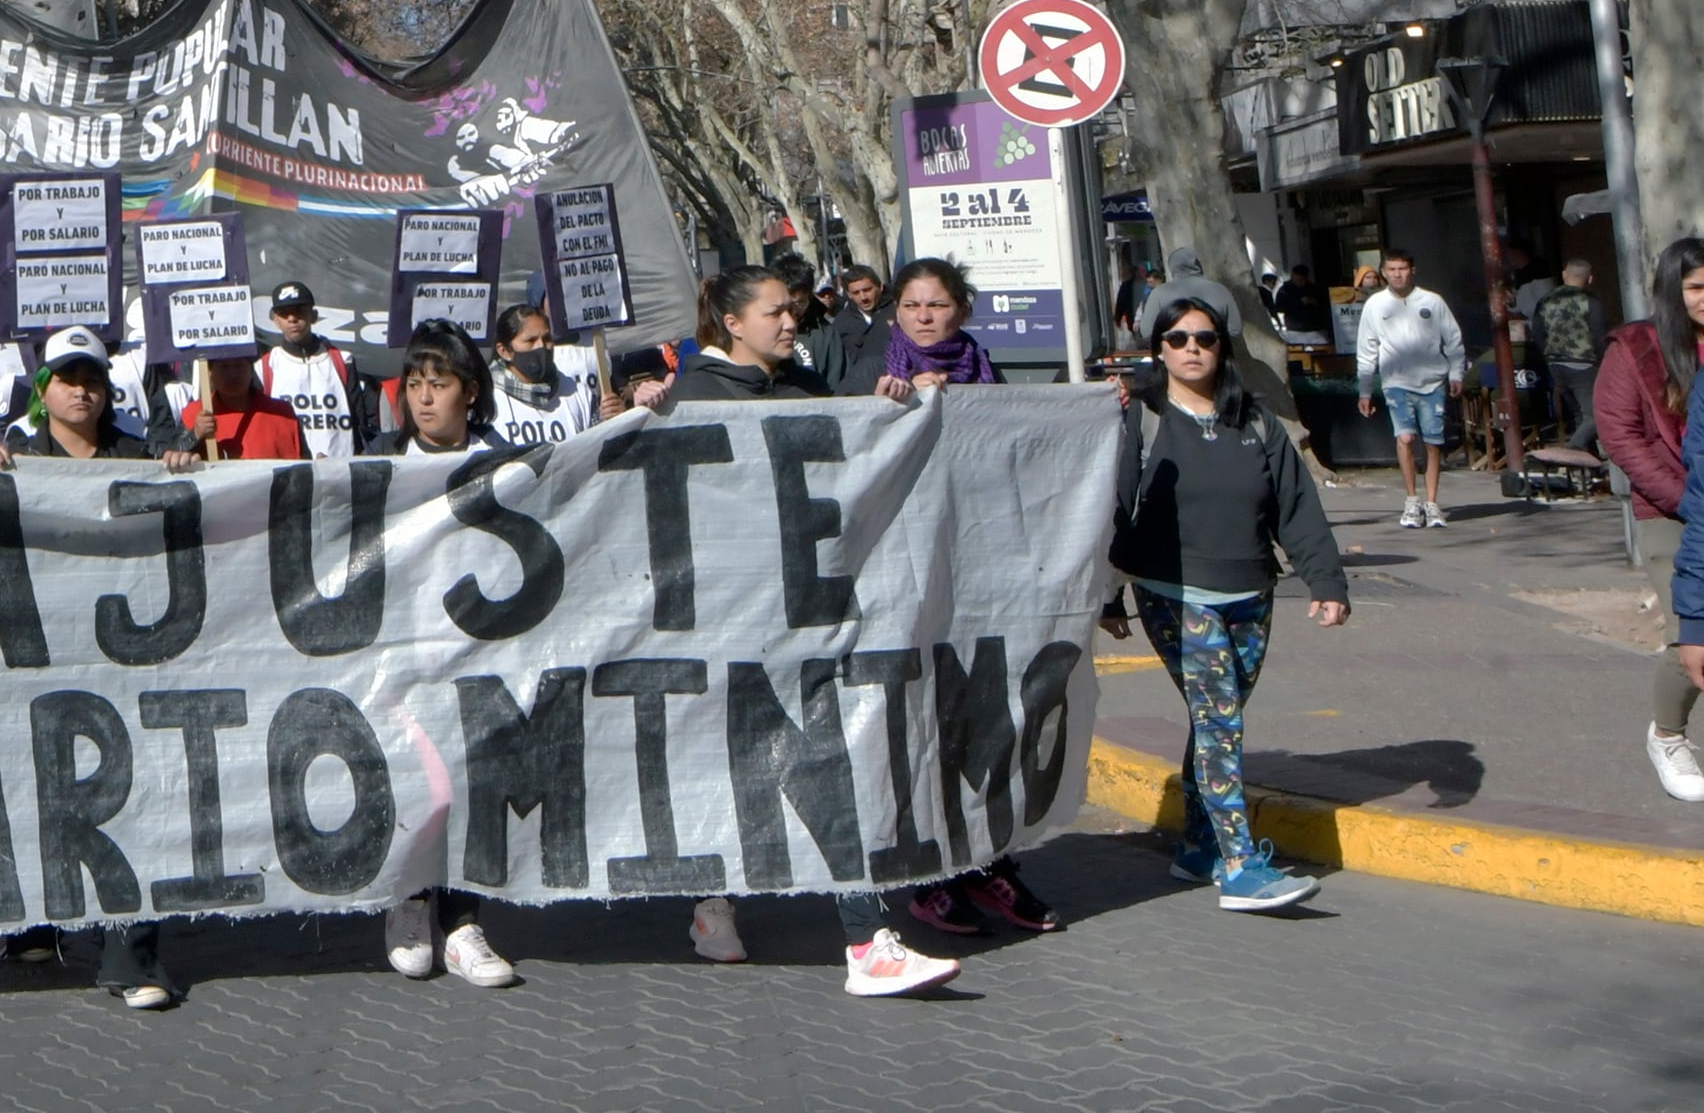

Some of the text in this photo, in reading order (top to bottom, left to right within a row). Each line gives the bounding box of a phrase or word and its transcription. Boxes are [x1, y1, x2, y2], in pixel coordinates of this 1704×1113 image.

[1364, 47, 1405, 93] OLD
[139, 61, 363, 166] SANTILLAN
[1367, 77, 1457, 144] SETTER
[921, 124, 967, 154] BOCAS
[923, 148, 970, 176] ABIERTAS
[284, 162, 425, 192] PLURINACIONAL
[18, 186, 100, 200] POR TRABAJO
[556, 189, 603, 207] ANULACION
[940, 188, 1030, 216] 2 al 4
[56, 208, 63, 220] Y
[560, 214, 604, 229] DEL PACTO
[404, 219, 478, 232] PARO NACIONAL
[942, 215, 1032, 229] SEPTIEMBRE
[22, 227, 99, 241] POR SALARIO
[144, 227, 222, 242] PARO NACIONAL
[438, 237, 443, 246] Y
[181, 245, 187, 255] Y
[563, 236, 608, 252] CON EL FMI
[403, 252, 474, 263] PLAN DE LUCHA
[19, 263, 106, 277] PARO NACIONAL
[147, 259, 223, 274] PLAN DE LUCHA
[564, 260, 614, 278] NO AL PAGO
[60, 284, 67, 295] Y
[417, 287, 486, 299] POR TRABAJO
[581, 284, 605, 298] DE LA
[174, 291, 247, 305] POR TRABAJO
[21, 300, 105, 315] PLAN DE LUCHA
[448, 305, 453, 315] Y
[583, 305, 611, 321] DEUDA
[209, 311, 215, 321] Y
[178, 325, 248, 340] POR SALARIO
[458, 320, 481, 331] ARIO
[505, 420, 566, 444] POLO
[454, 636, 1083, 894] MINIMO
